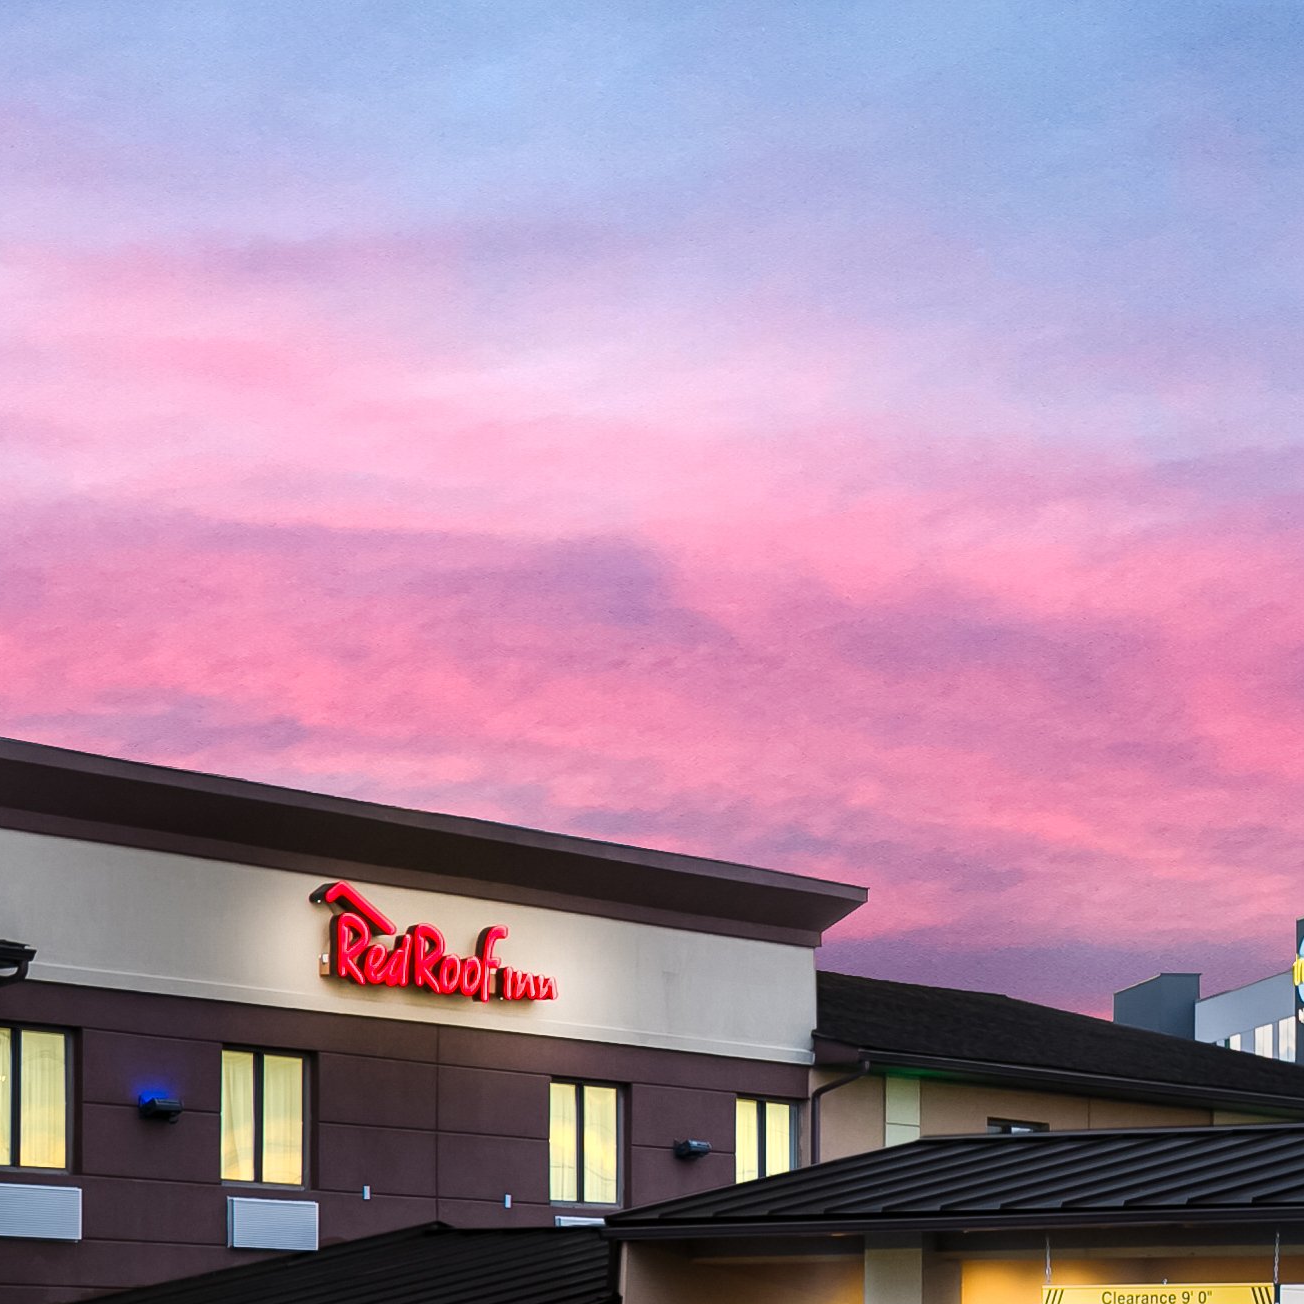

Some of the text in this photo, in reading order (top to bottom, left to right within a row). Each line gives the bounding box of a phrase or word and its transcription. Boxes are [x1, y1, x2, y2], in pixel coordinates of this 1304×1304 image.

[330, 911, 559, 1003] Red Roof Inn
[1101, 1291, 1213, 1304] Clearance 9' 0"
